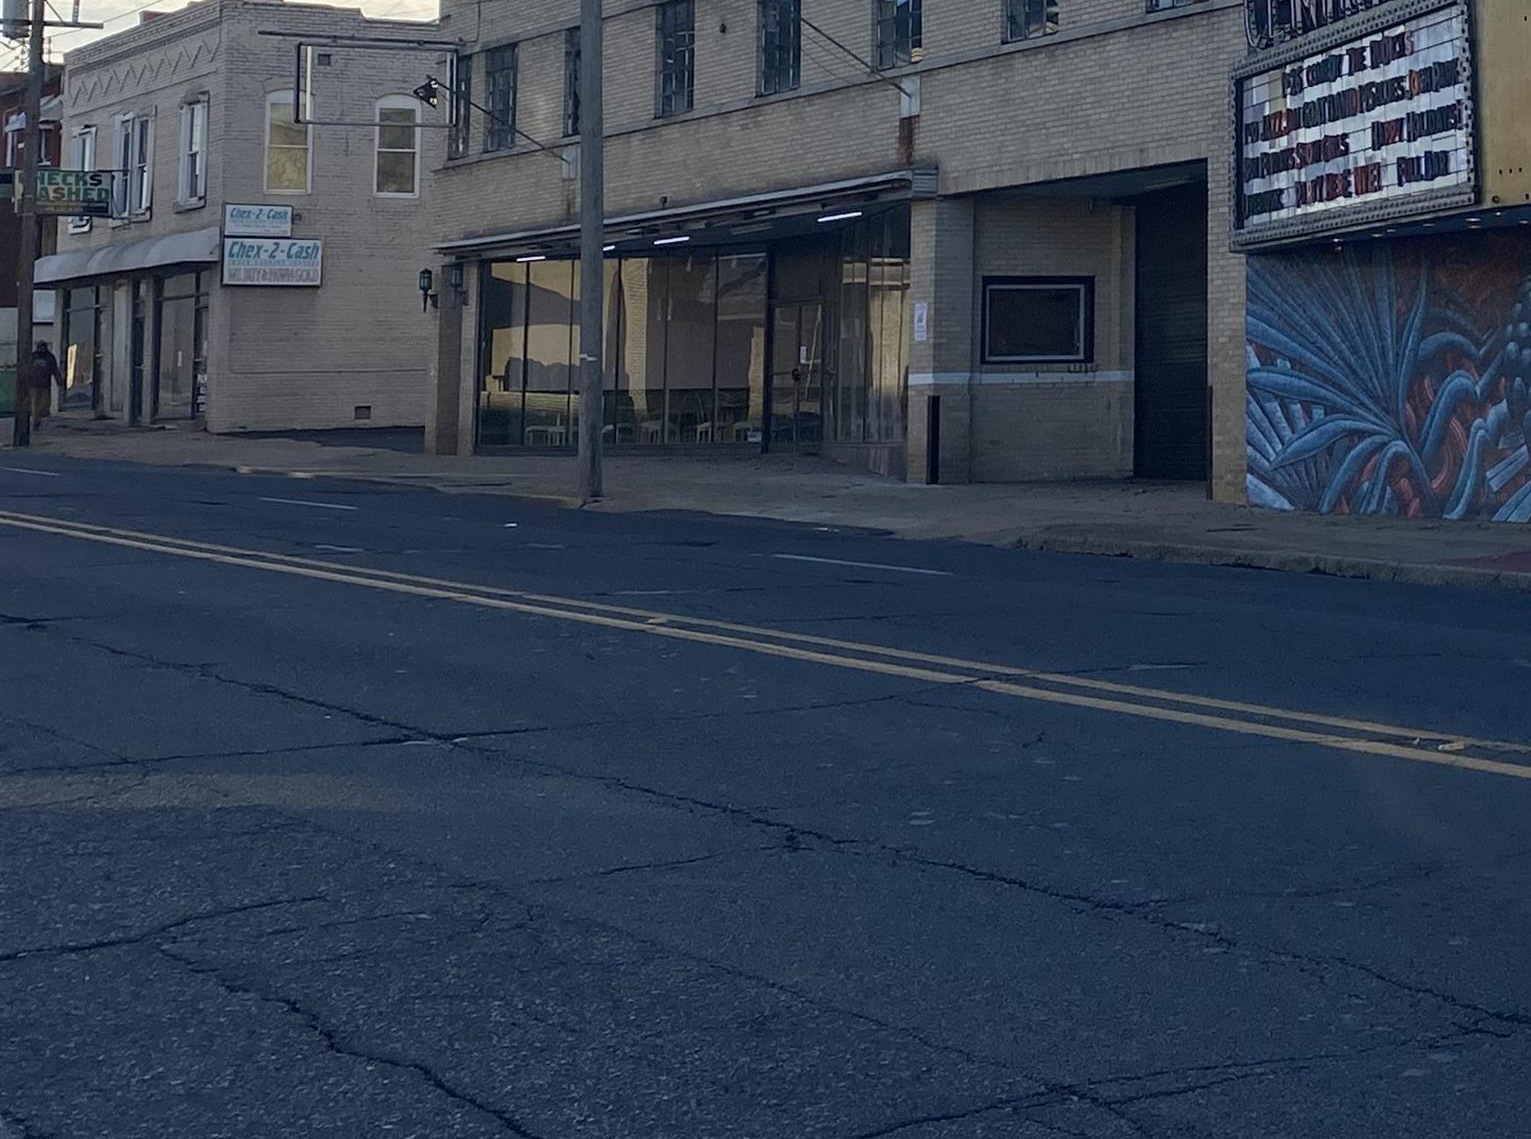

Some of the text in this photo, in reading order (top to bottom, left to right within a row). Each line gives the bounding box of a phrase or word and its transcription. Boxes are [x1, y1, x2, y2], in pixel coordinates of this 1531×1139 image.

[36, 172, 102, 187] HECKS
[36, 187, 110, 201] ASHED
[228, 241, 320, 260] Chex-2-Cash
